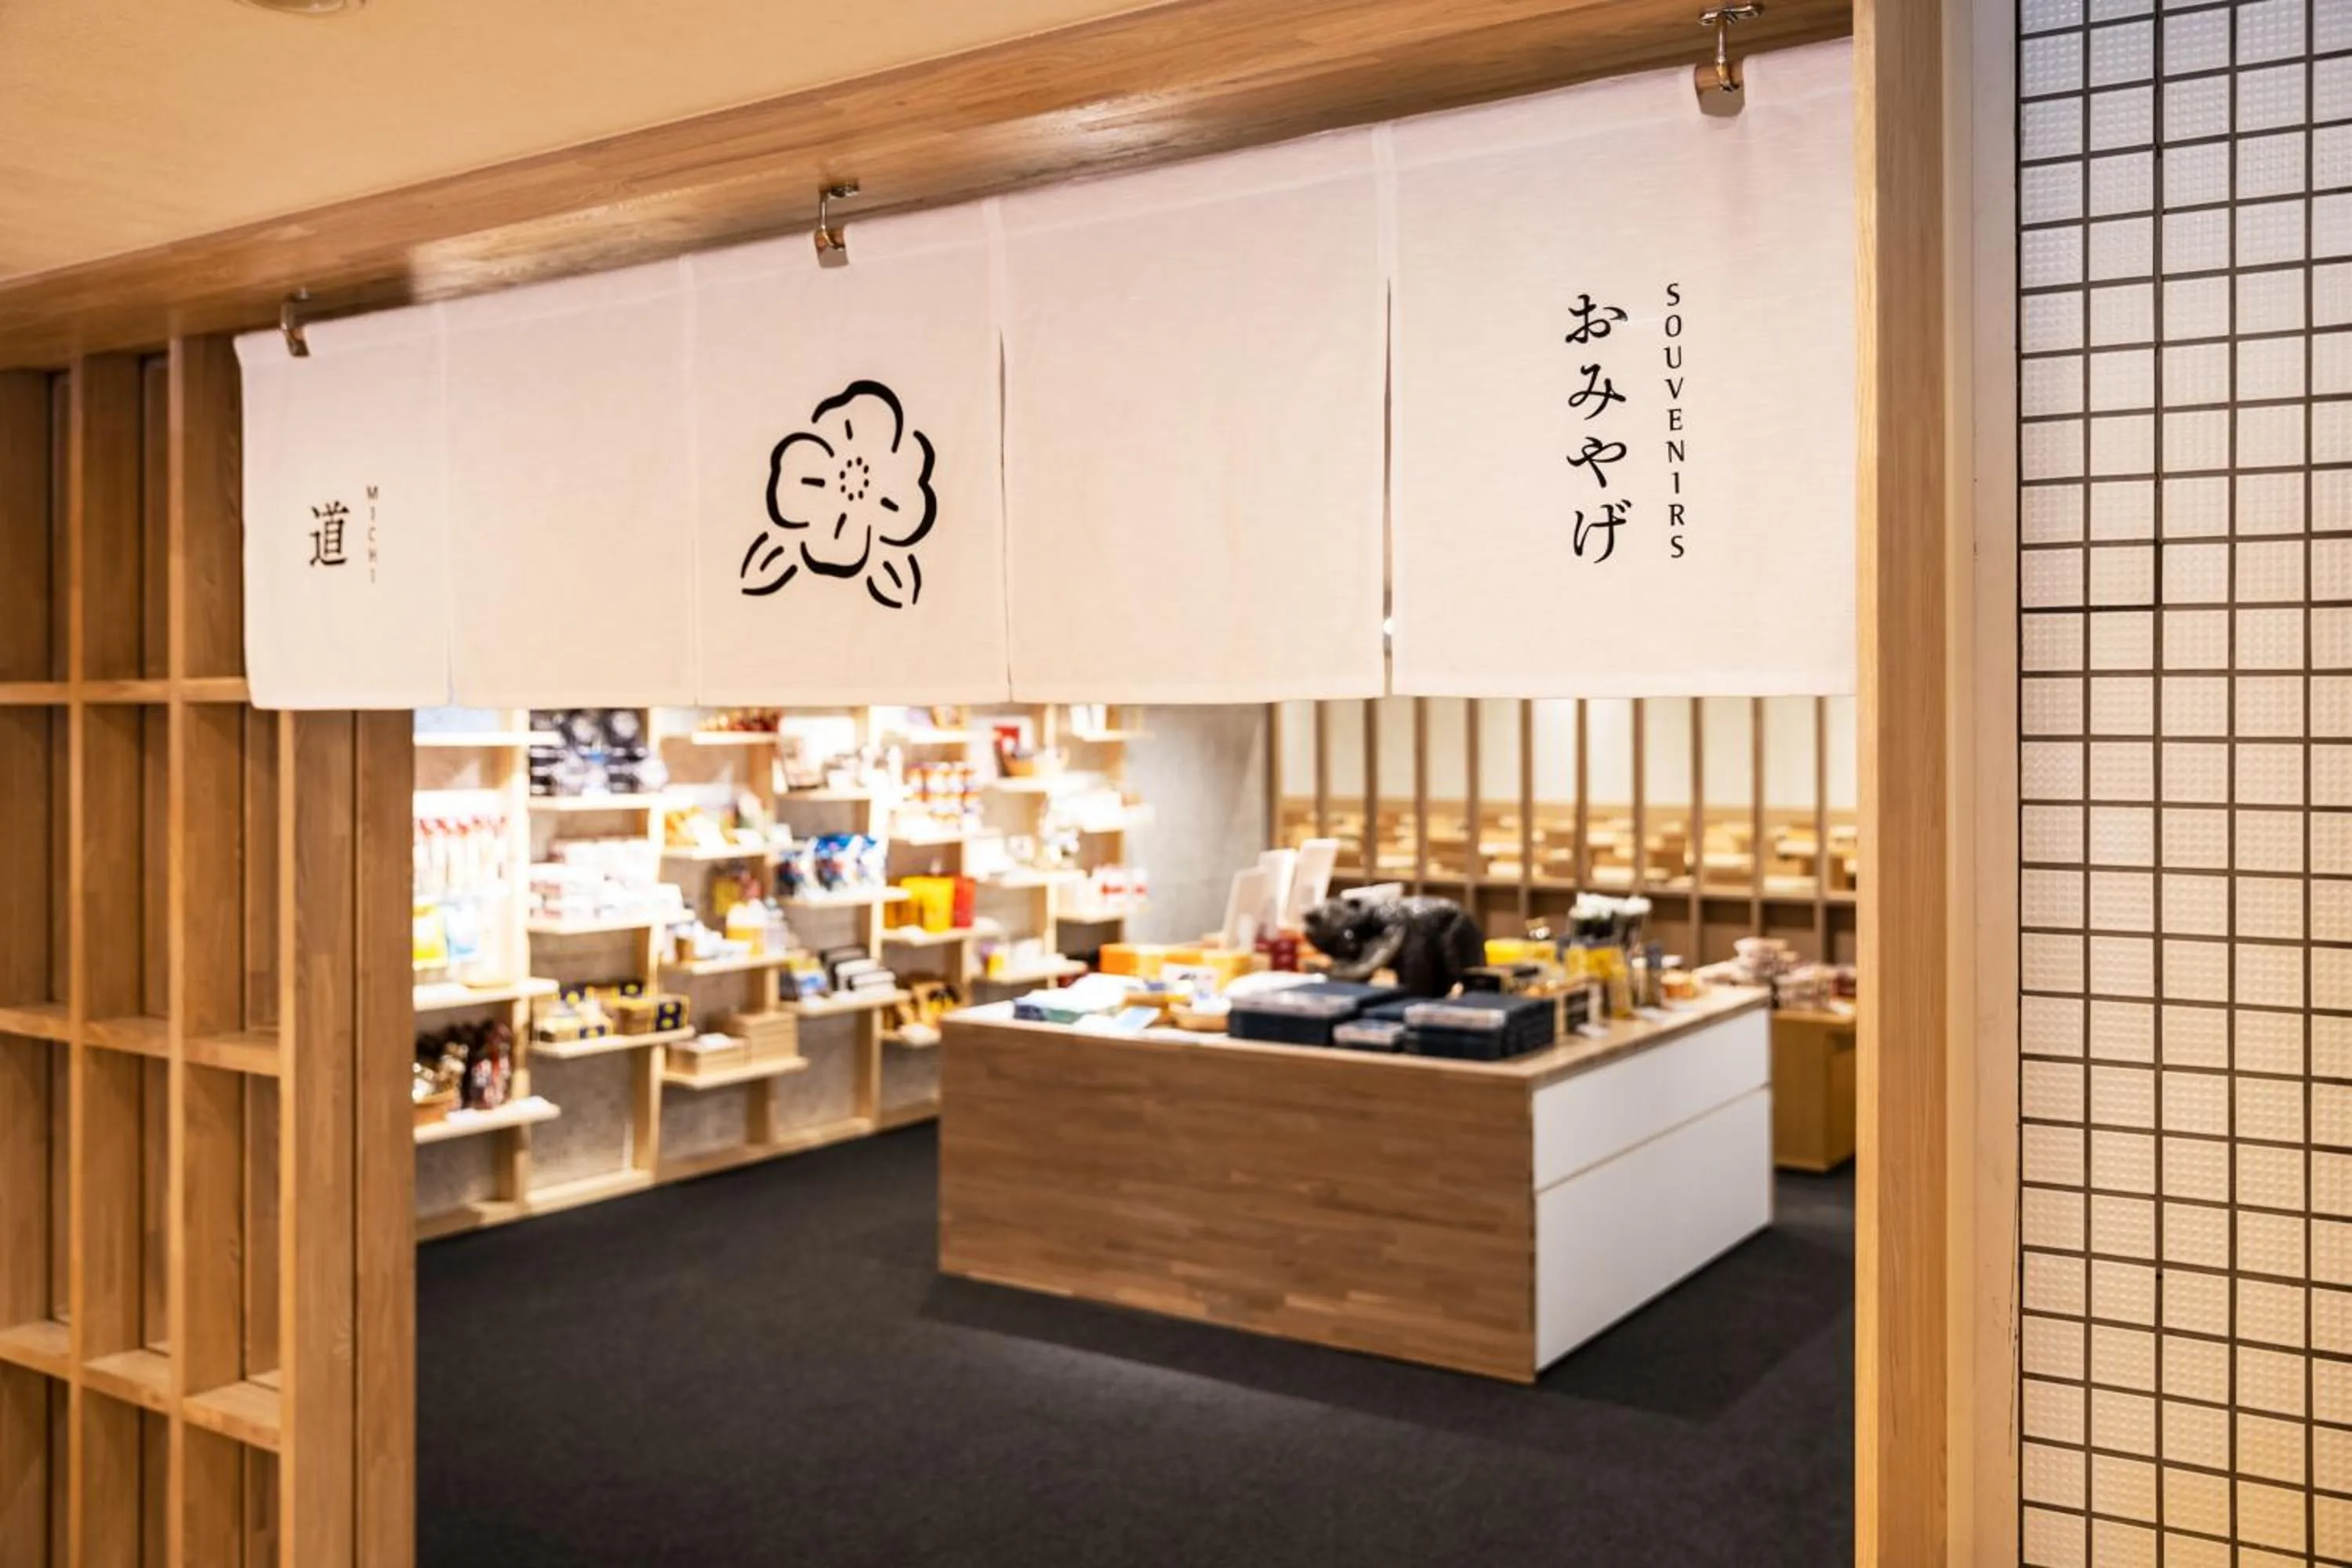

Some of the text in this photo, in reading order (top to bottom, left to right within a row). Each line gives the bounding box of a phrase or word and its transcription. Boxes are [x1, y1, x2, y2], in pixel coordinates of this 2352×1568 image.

[1564, 292, 1633, 564] おみやげ
[1663, 282, 1686, 559] SOUVENIRS
[309, 499, 350, 568] 道
[366, 485, 379, 585] MICHI
